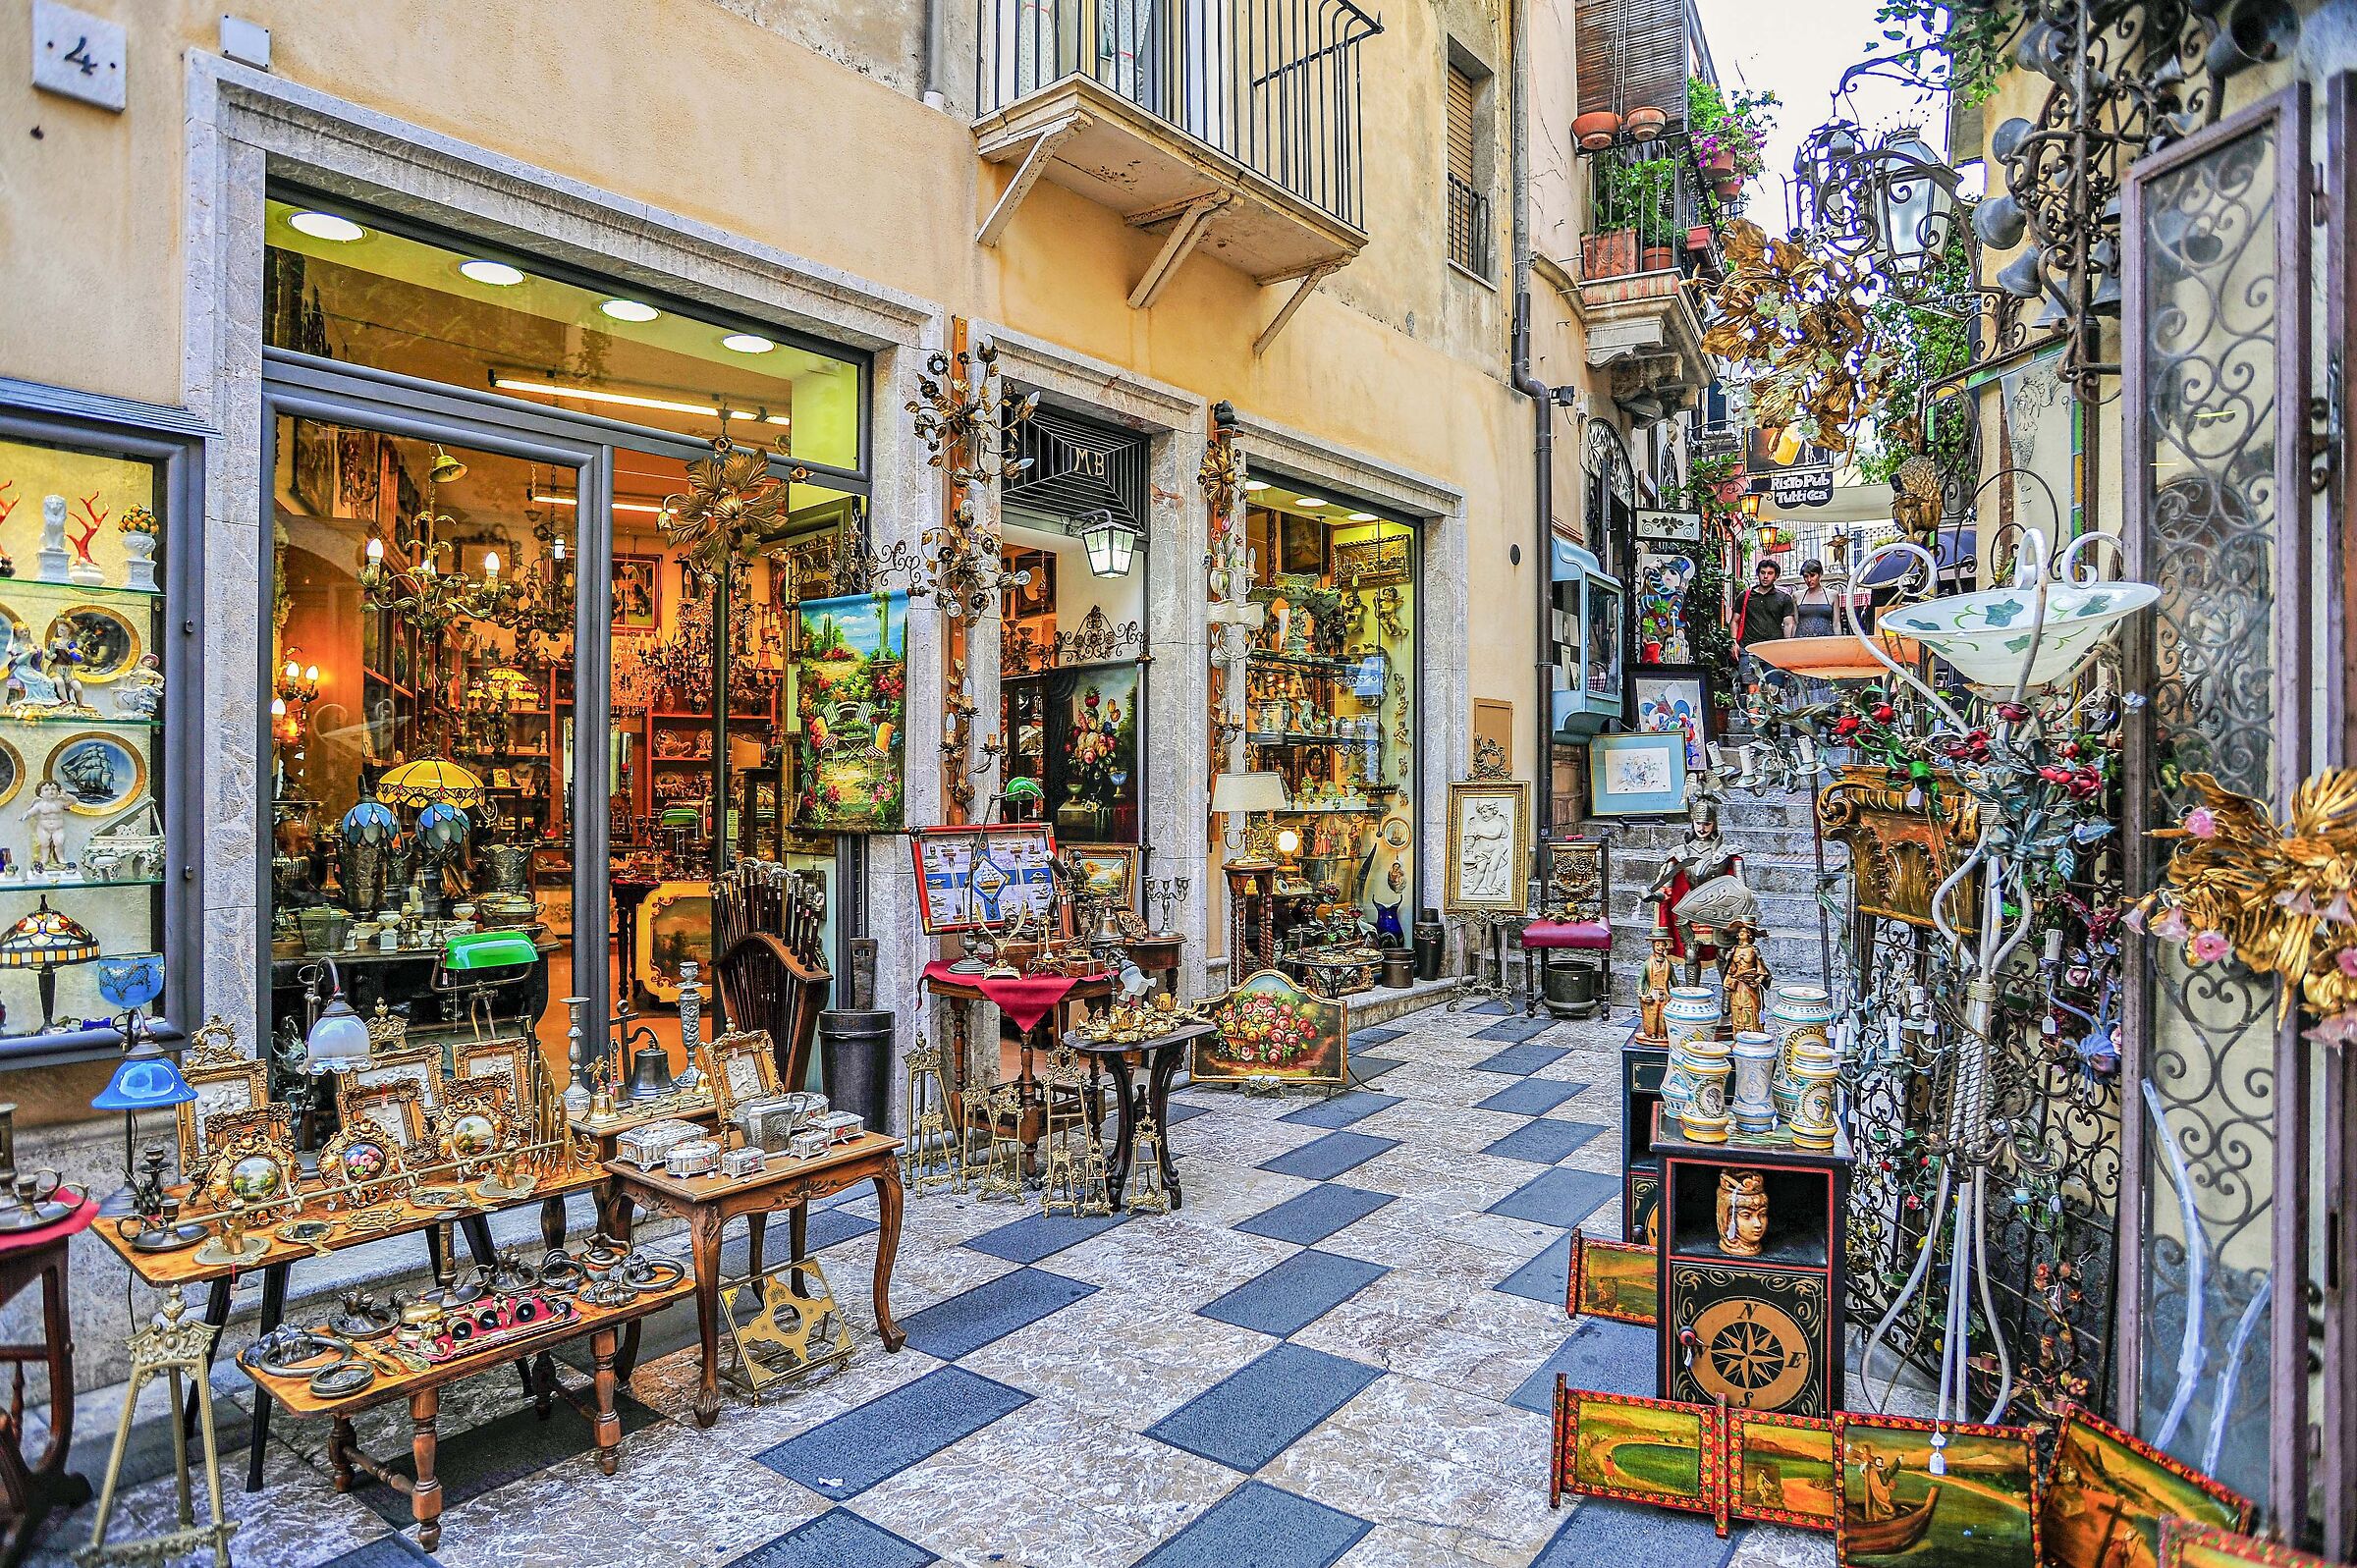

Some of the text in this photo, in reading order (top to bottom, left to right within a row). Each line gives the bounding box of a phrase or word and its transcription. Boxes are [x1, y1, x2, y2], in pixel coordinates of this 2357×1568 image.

[64, 35, 98, 76] 4
[1803, 472, 1831, 488] Pub
[1776, 489, 1807, 504] Tutti
[1736, 1302, 1760, 1321] N
[1784, 1351, 1807, 1369] E
[1738, 1391, 1754, 1408] S
